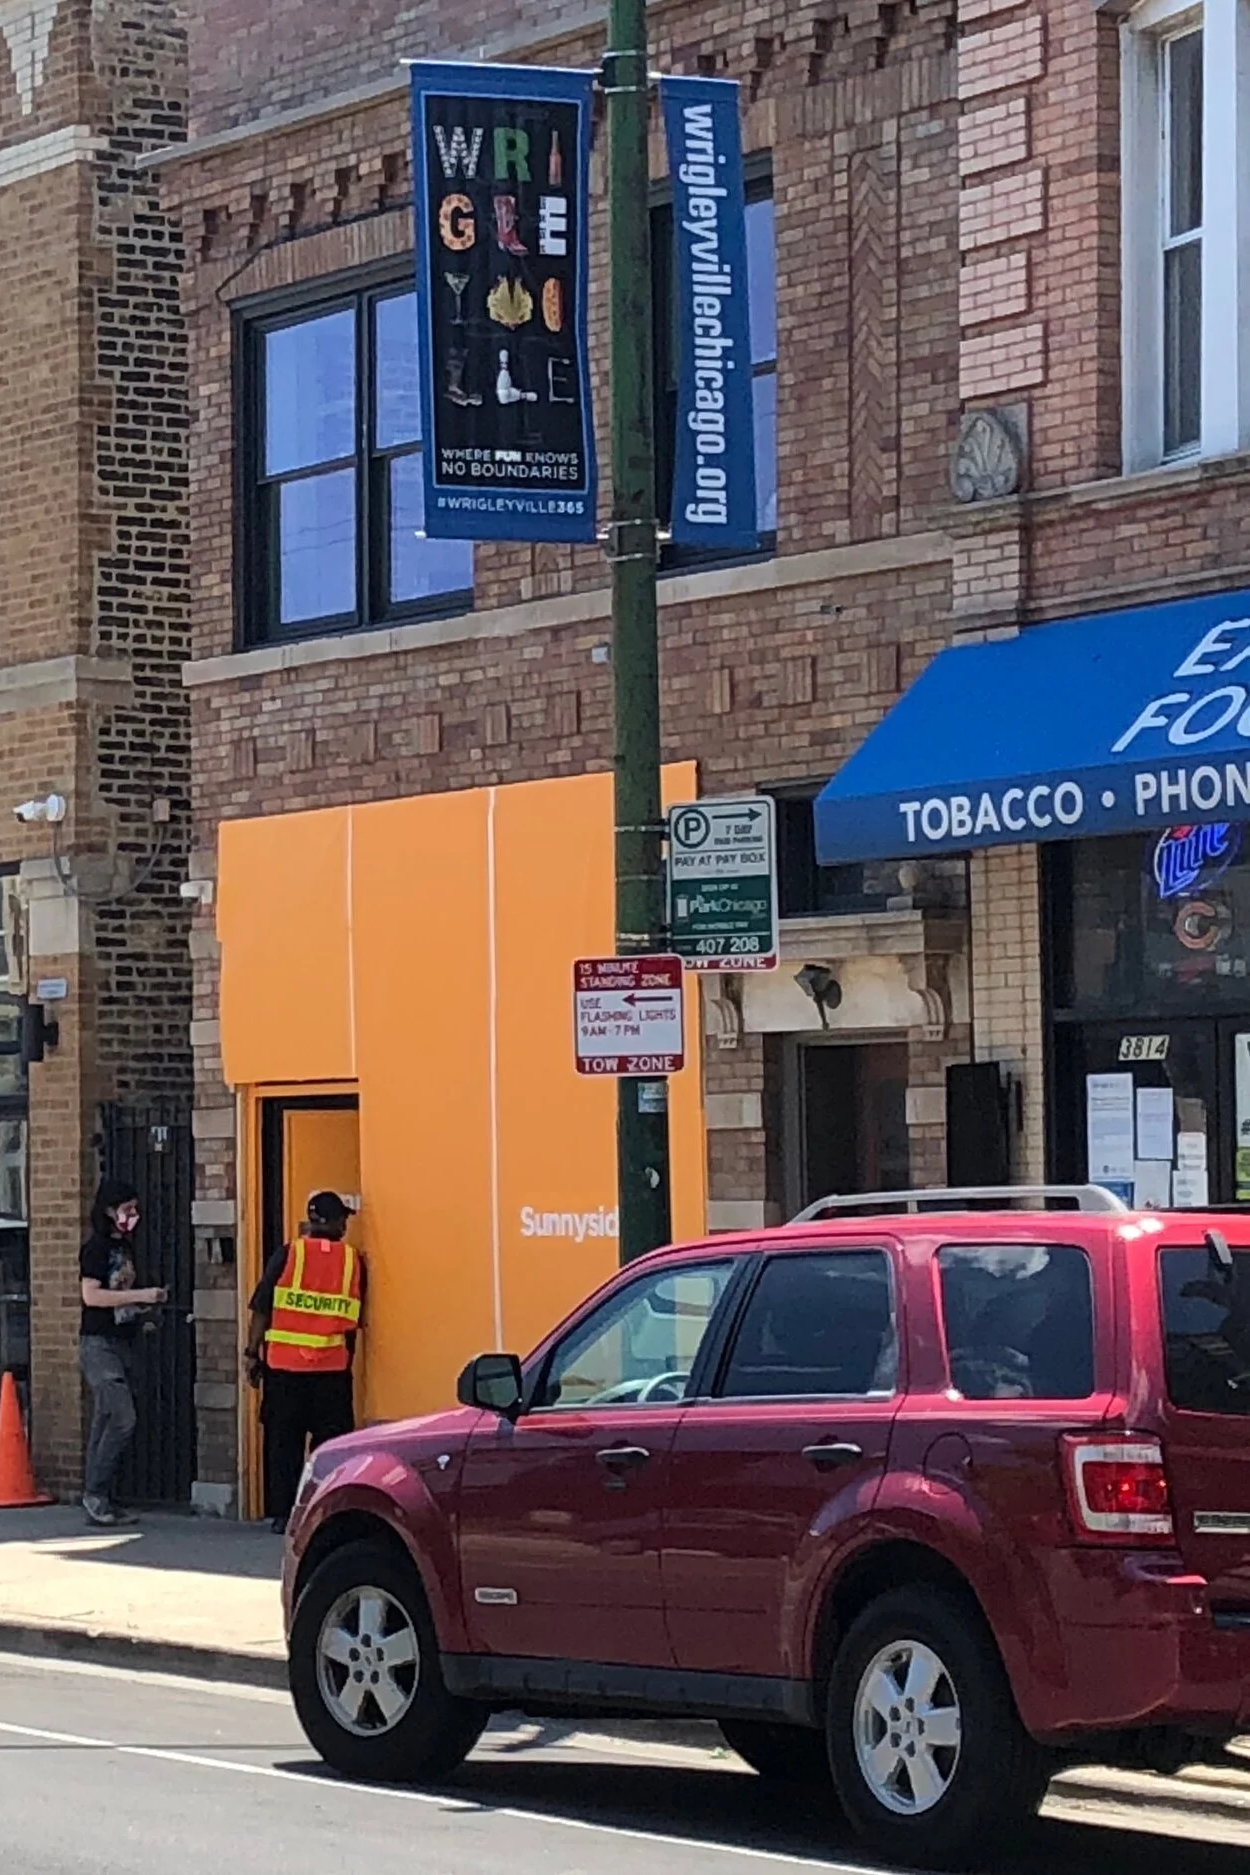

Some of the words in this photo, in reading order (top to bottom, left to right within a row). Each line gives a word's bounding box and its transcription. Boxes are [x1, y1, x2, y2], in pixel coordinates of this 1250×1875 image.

[678, 103, 736, 526] wrigleyvillechicago.org
[441, 448, 491, 462] WHERE
[494, 450, 522, 463] FUN
[525, 452, 579, 465] KNOWS
[441, 462, 466, 476] NO
[471, 463, 579, 480] BOUNDARIES
[900, 781, 1084, 843] TOBACCO
[1134, 761, 1250, 816] PHON
[675, 856, 696, 867] PAY
[698, 855, 712, 866] AT
[715, 854, 736, 866] PAY
[740, 852, 766, 863] BOX
[696, 938, 725, 954] 407
[730, 936, 760, 952] 208
[579, 963, 592, 975] 15
[597, 962, 639, 974] MINUTE
[719, 957, 767, 968] ZONE
[580, 974, 636, 988] STANDING
[641, 973, 671, 987] ZONE
[580, 997, 601, 1009] USE
[580, 1010, 633, 1022] FLASHING
[639, 1009, 676, 1021] LIGHTS
[1121, 1037, 1167, 1059] 3814
[583, 1057, 619, 1072] TOW
[628, 1055, 676, 1072] ZONE
[520, 1204, 620, 1243] Sunnysid
[286, 1291, 351, 1314] SECURITY
